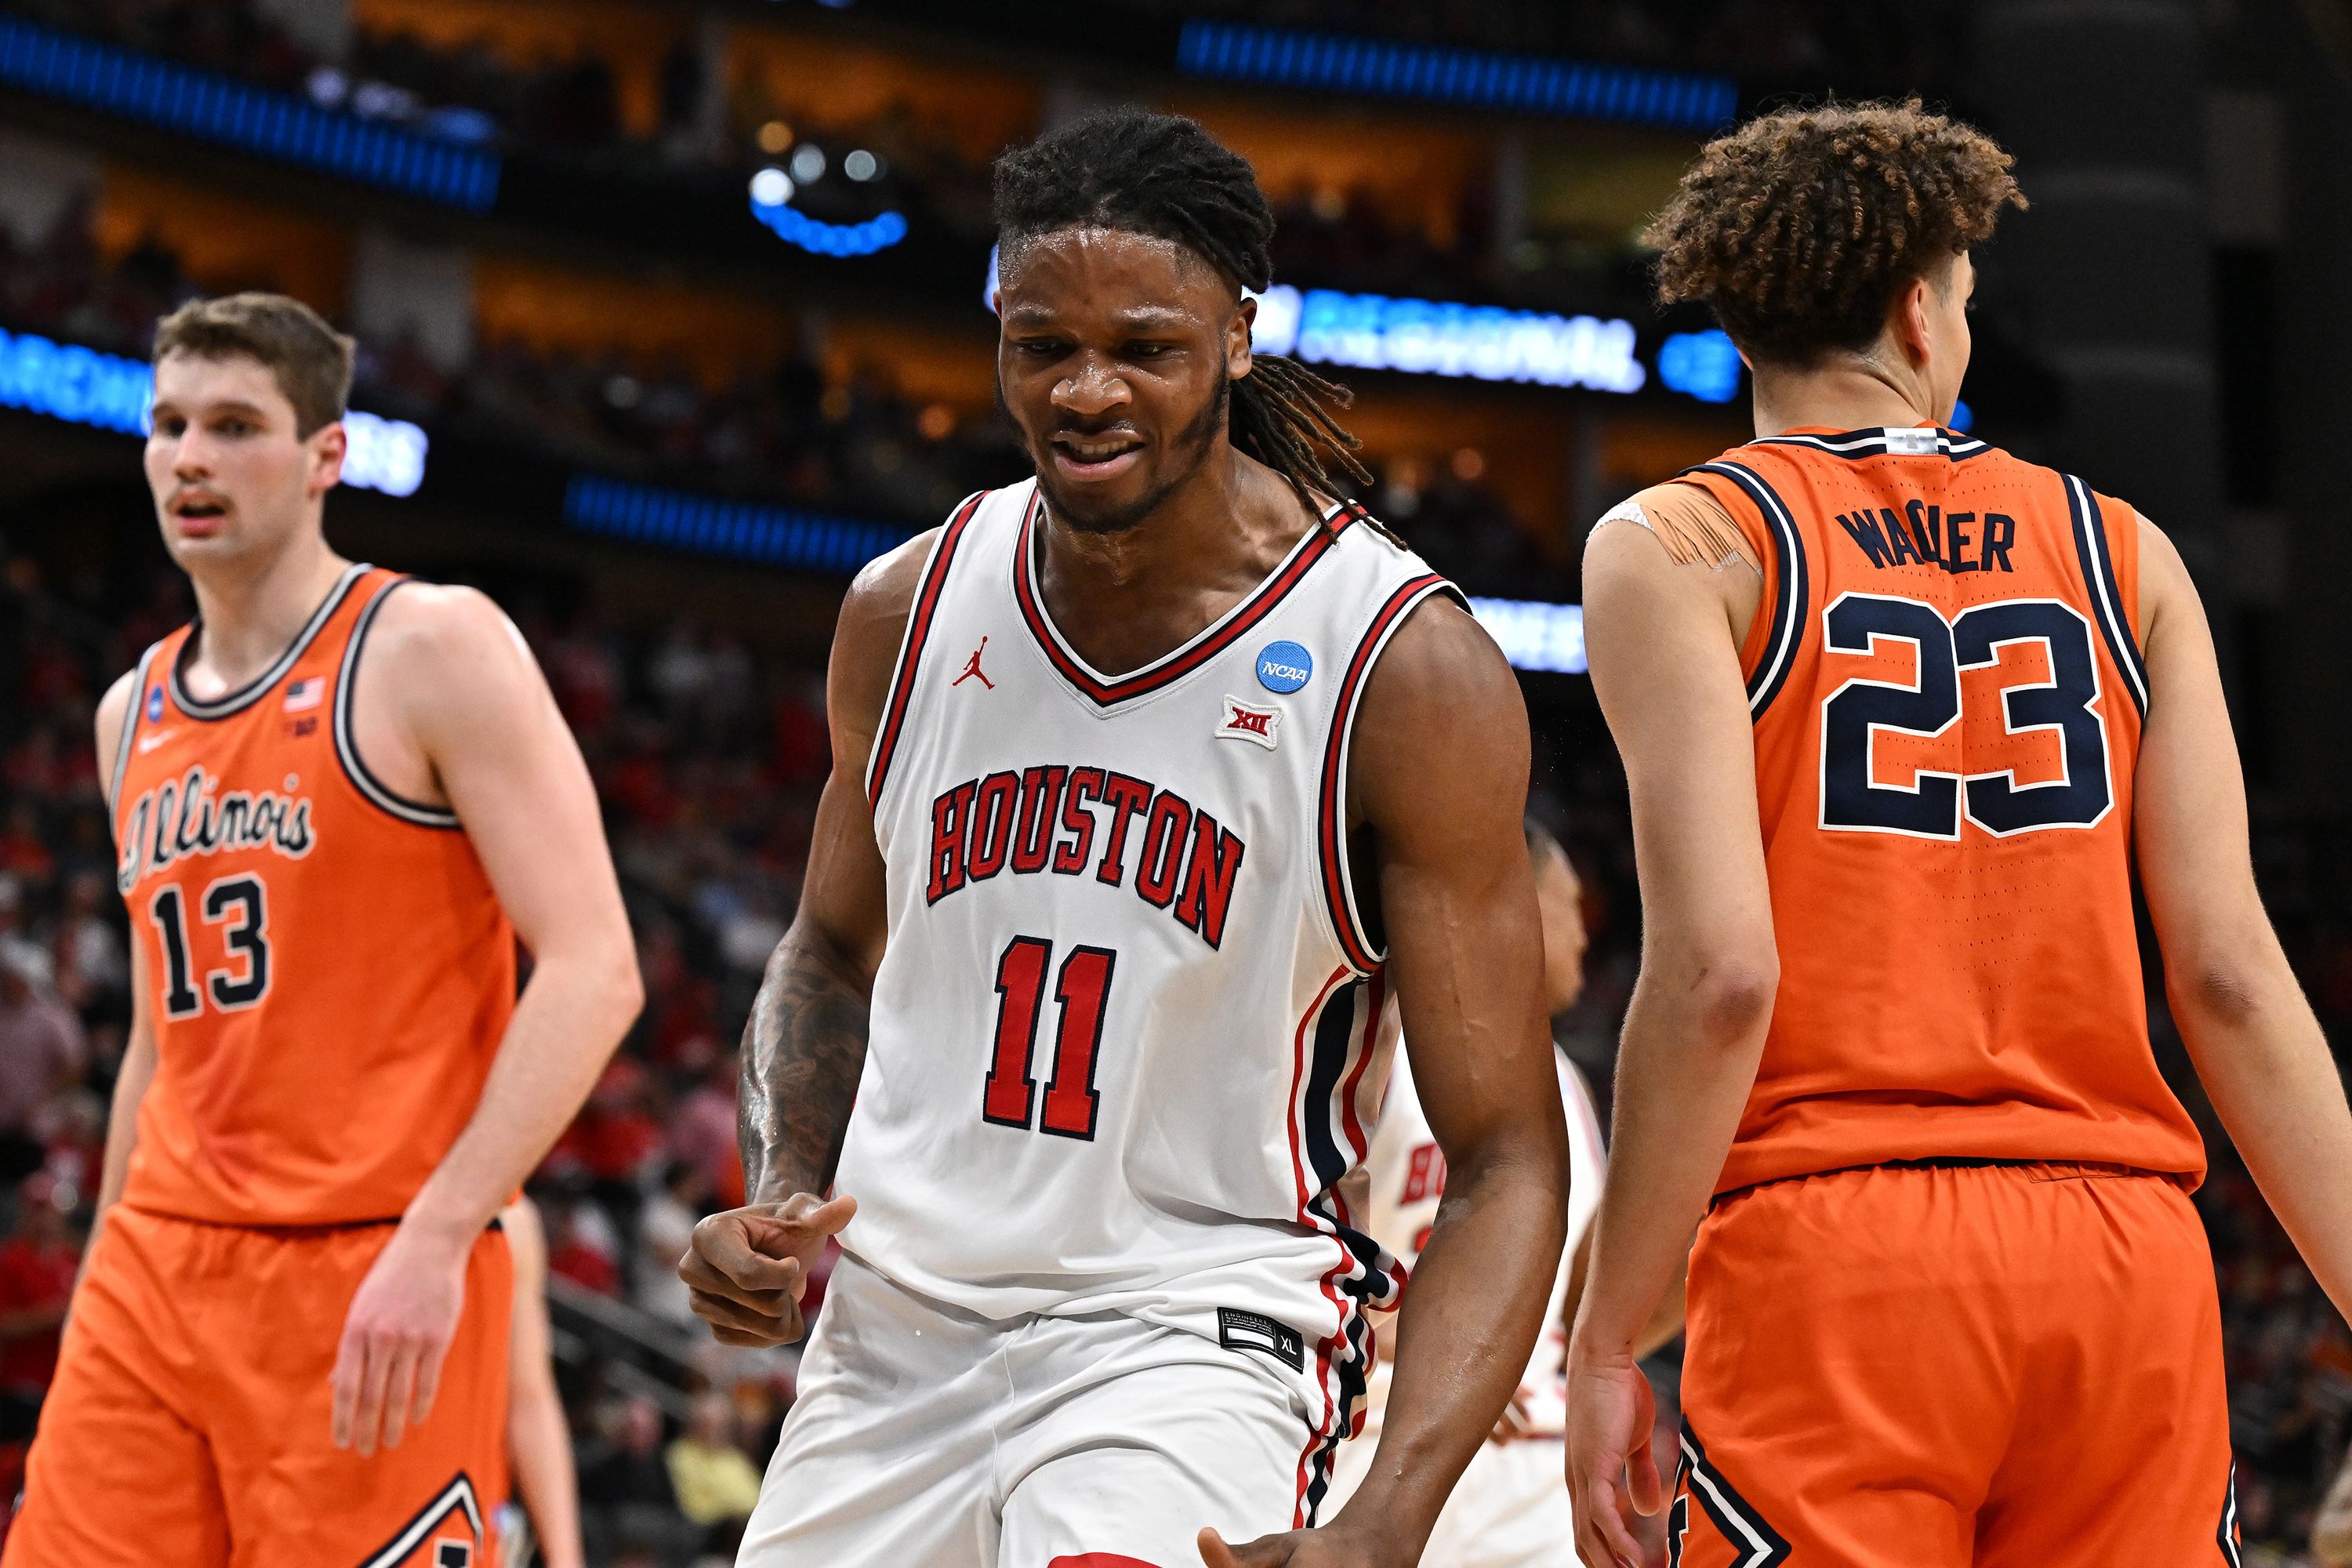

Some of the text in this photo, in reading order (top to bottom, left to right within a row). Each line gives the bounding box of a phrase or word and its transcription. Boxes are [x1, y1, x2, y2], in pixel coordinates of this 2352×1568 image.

[1226, 706, 1273, 737] XII
[1261, 661, 1308, 683] NCAA
[1817, 590, 2115, 842] 23
[117, 764, 316, 895] Illinois
[927, 764, 1245, 952] HOUSTON
[149, 869, 273, 1024] 13
[982, 934, 1117, 1142] 11
[1280, 1334, 1298, 1356] XL
